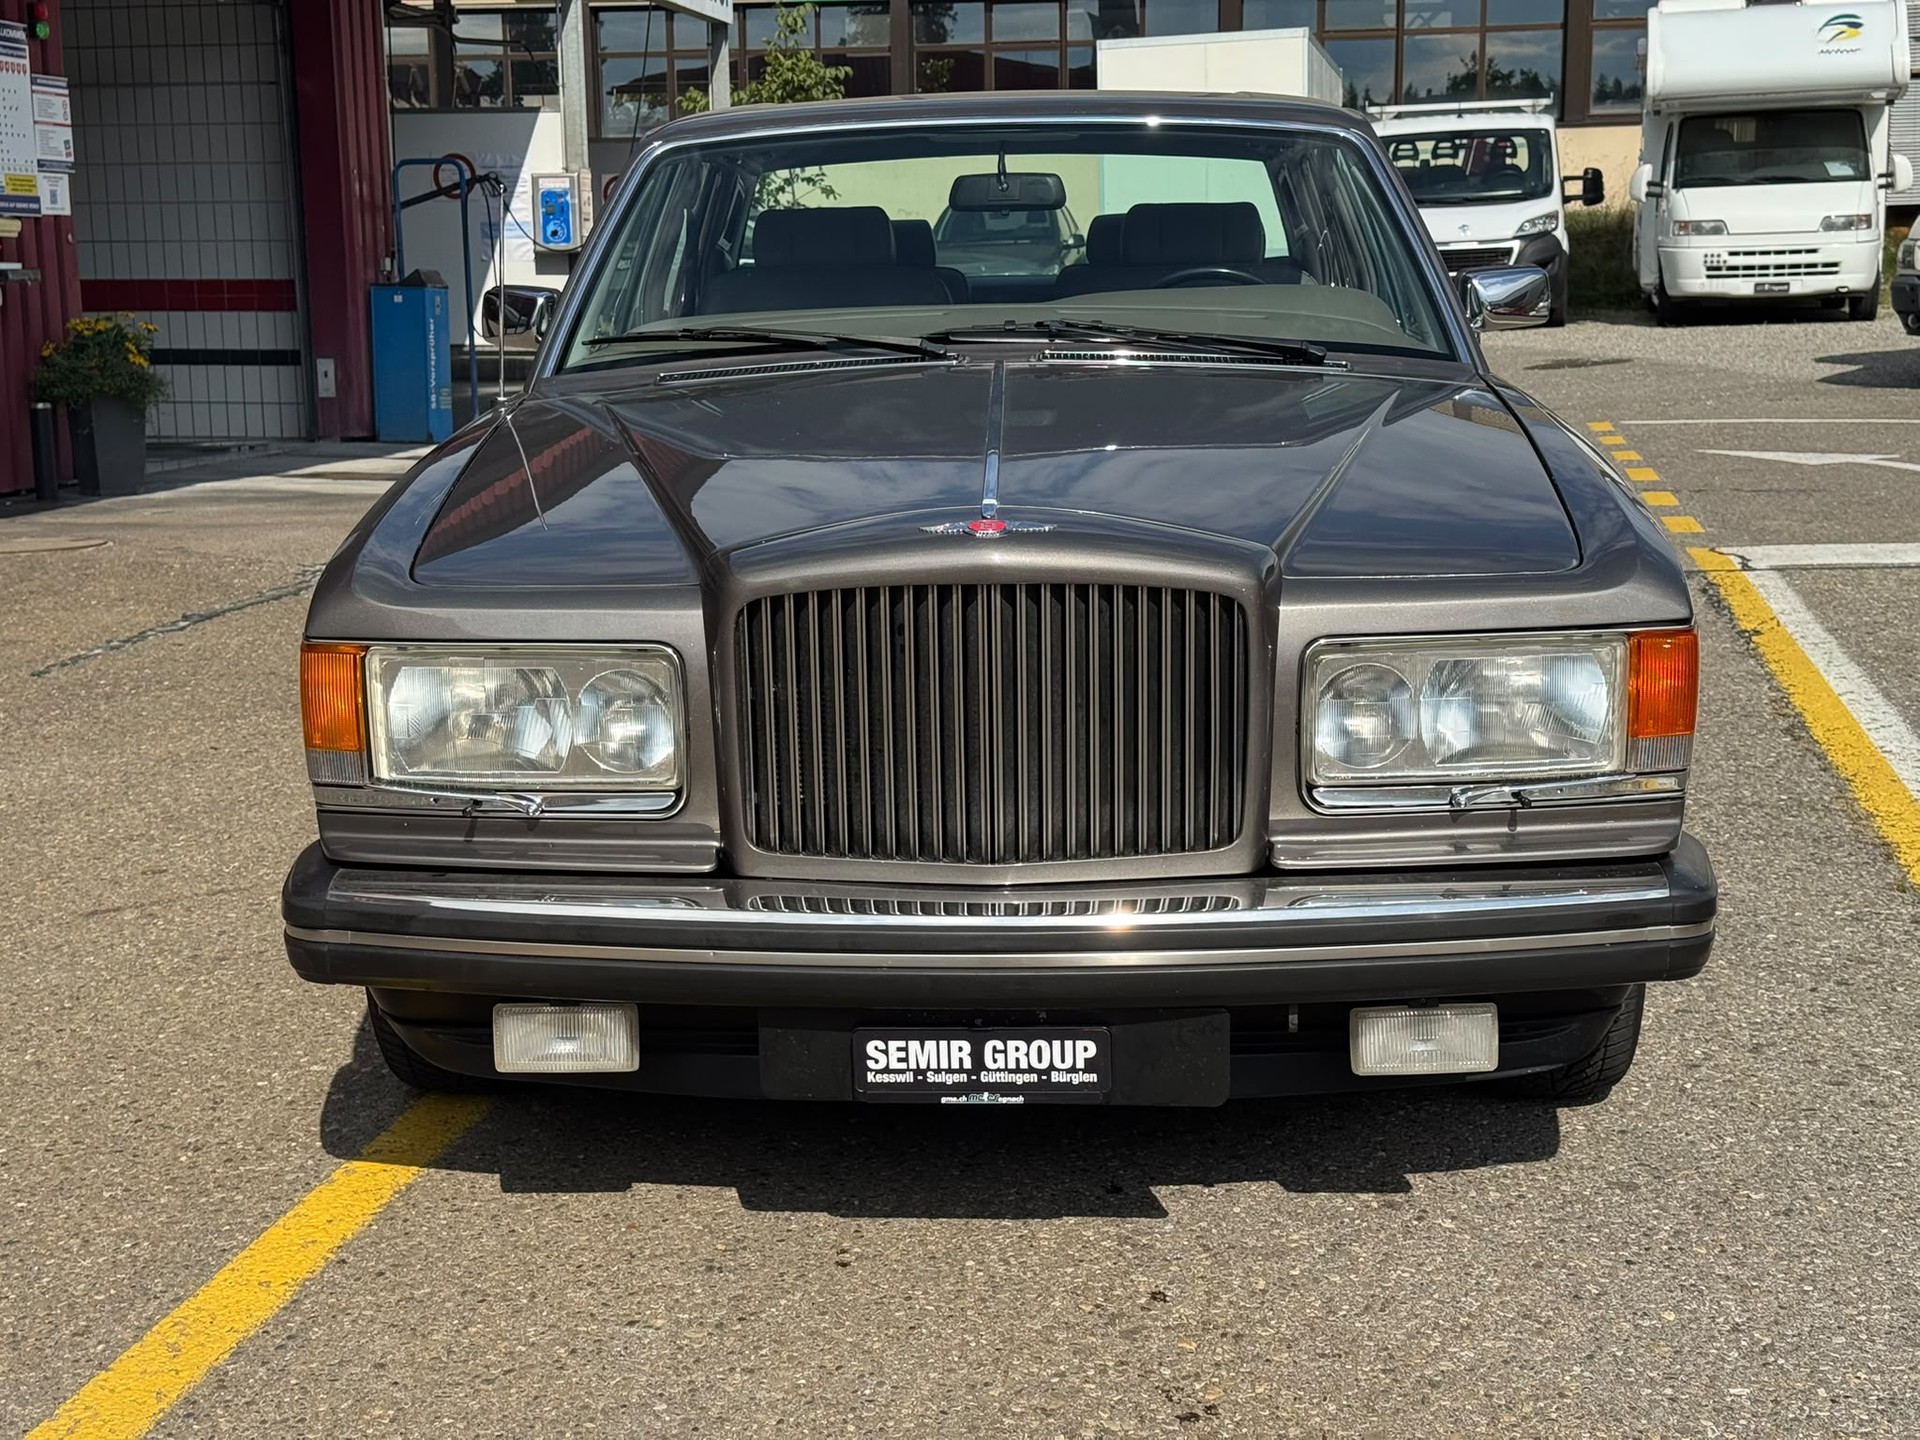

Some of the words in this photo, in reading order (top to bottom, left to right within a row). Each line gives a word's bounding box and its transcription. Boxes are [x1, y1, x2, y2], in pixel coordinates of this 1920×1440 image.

[866, 1040, 972, 1070] SEMIR
[984, 1039, 1097, 1070] GROUP
[867, 1071, 914, 1083] Kesswil
[926, 1071, 968, 1085] Sulgen
[980, 1071, 1038, 1085] Güttingen
[1051, 1071, 1098, 1085] Bürglen
